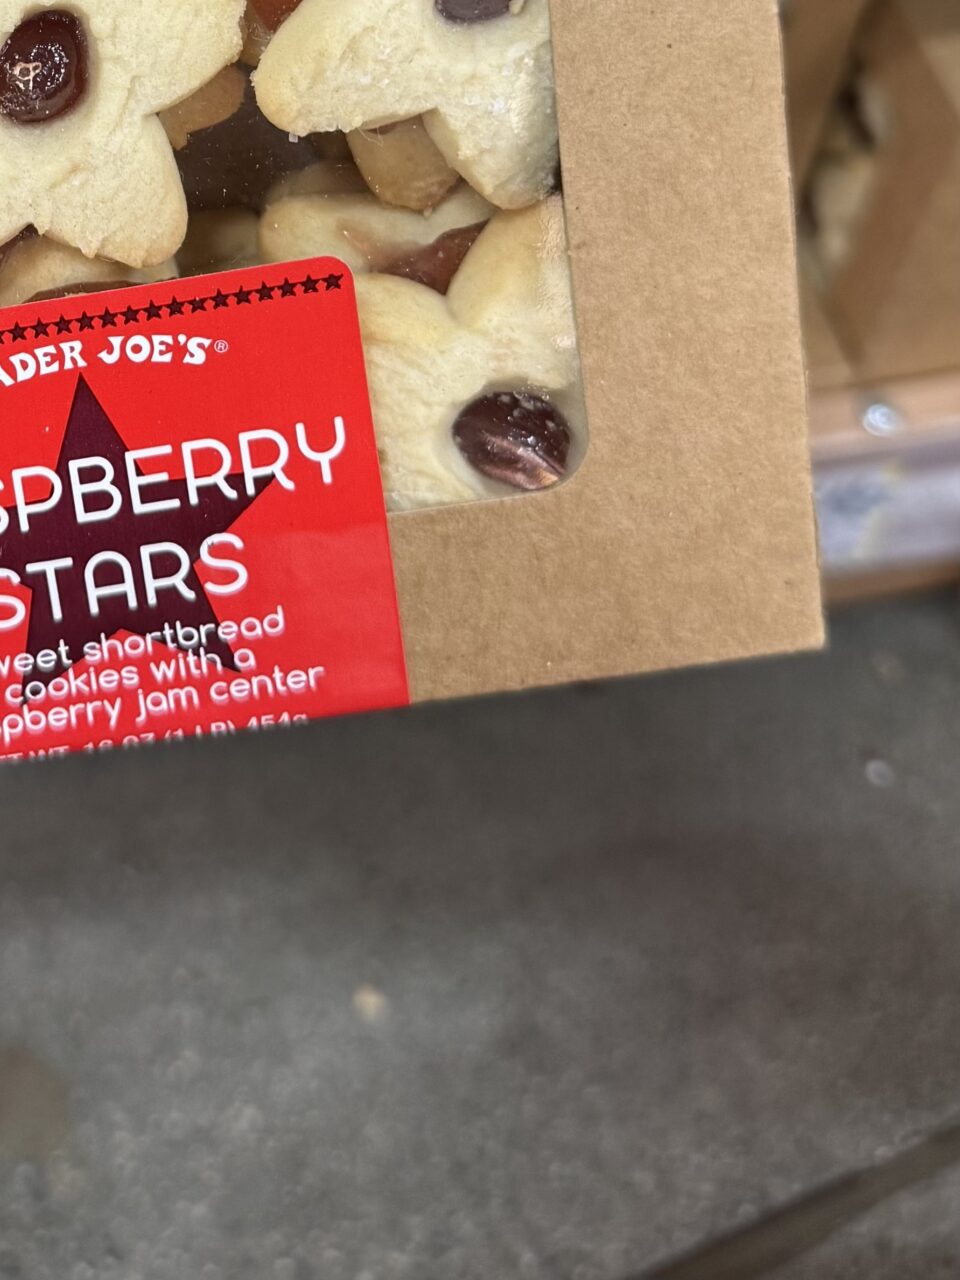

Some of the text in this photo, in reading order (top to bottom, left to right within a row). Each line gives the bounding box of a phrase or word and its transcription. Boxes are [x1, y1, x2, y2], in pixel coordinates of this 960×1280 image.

[83, 605, 286, 663] shortbread
[4, 647, 256, 706] cookies with a
[135, 683, 200, 723] jam
[209, 664, 325, 703] center
